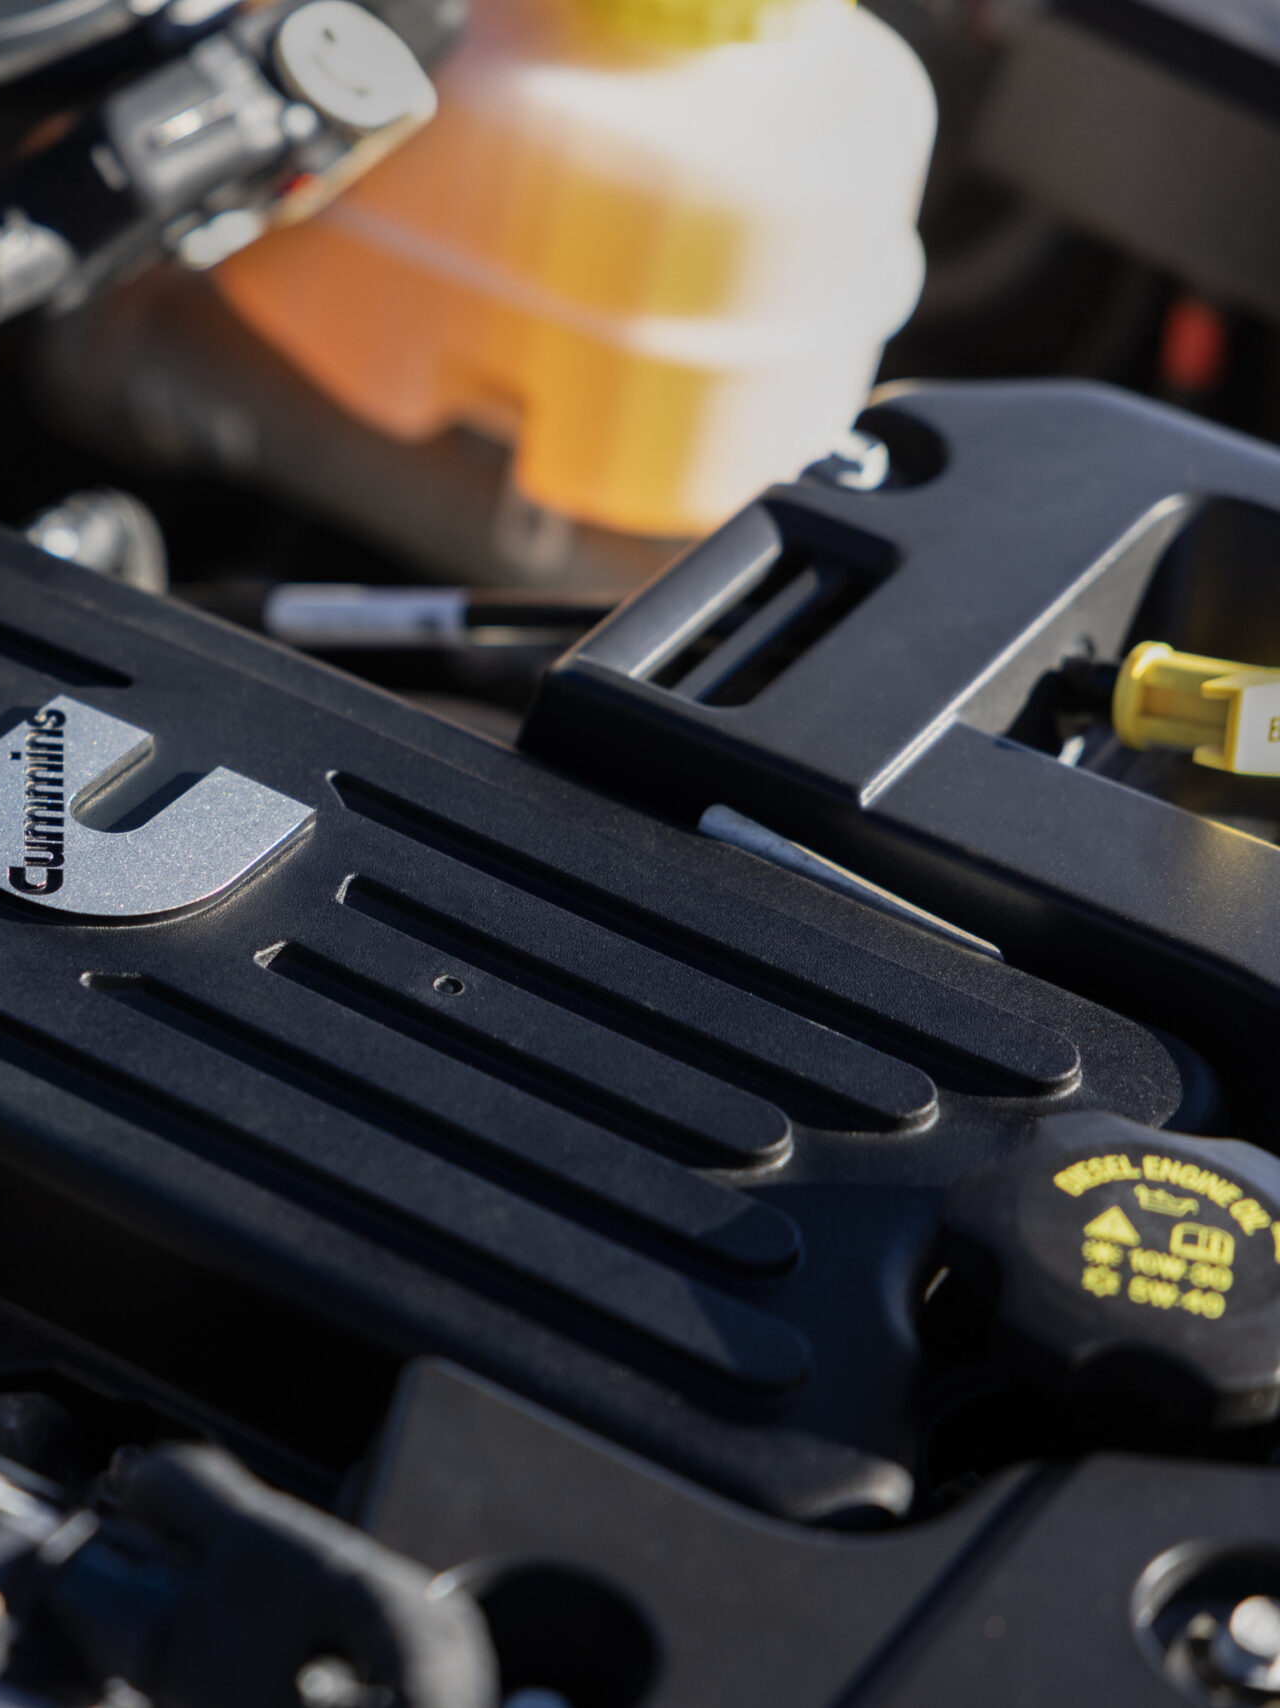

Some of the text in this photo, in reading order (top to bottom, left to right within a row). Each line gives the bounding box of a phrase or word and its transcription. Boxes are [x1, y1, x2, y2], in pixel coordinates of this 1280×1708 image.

[8, 708, 67, 895] Cummins
[1053, 1154, 1141, 1197] DIESEL
[1142, 1154, 1243, 1208] ENGINE
